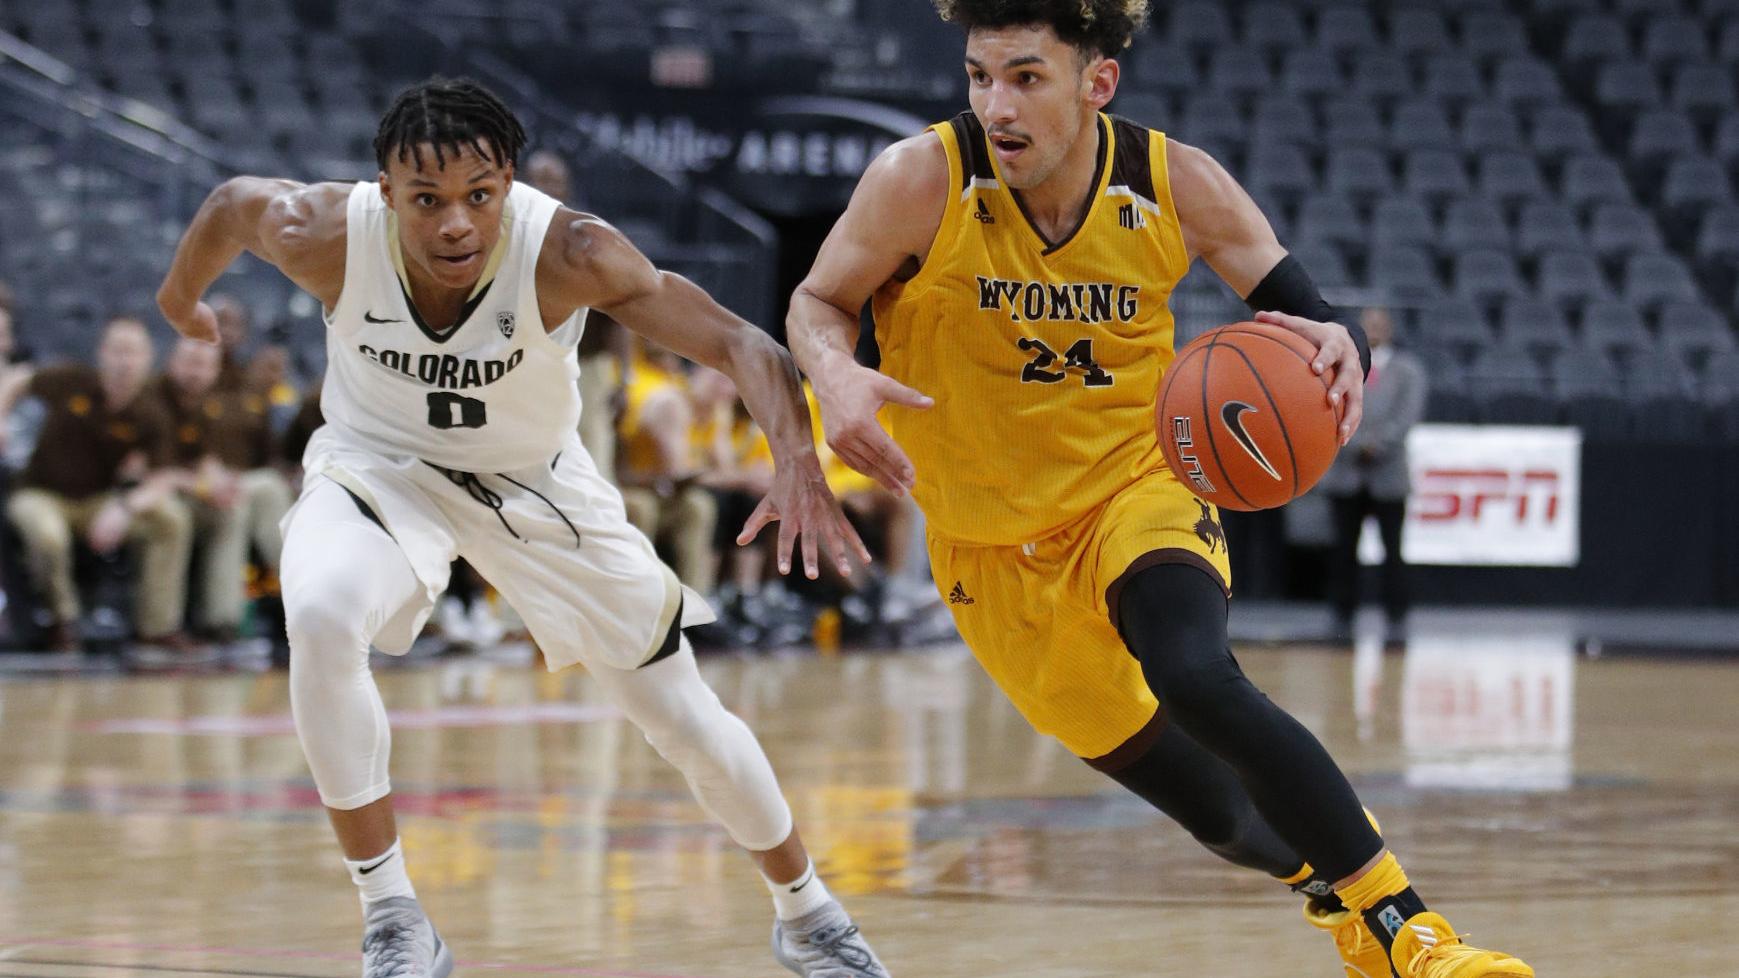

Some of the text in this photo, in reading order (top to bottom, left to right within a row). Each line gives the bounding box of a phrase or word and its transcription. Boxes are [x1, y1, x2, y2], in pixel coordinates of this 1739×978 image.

[975, 275, 1140, 324] WYOMING
[358, 344, 524, 389] COLORADO
[1017, 337, 1115, 387] 24
[426, 391, 487, 429] 0
[1173, 416, 1217, 493] ELITE
[1416, 468, 1559, 525] SPN
